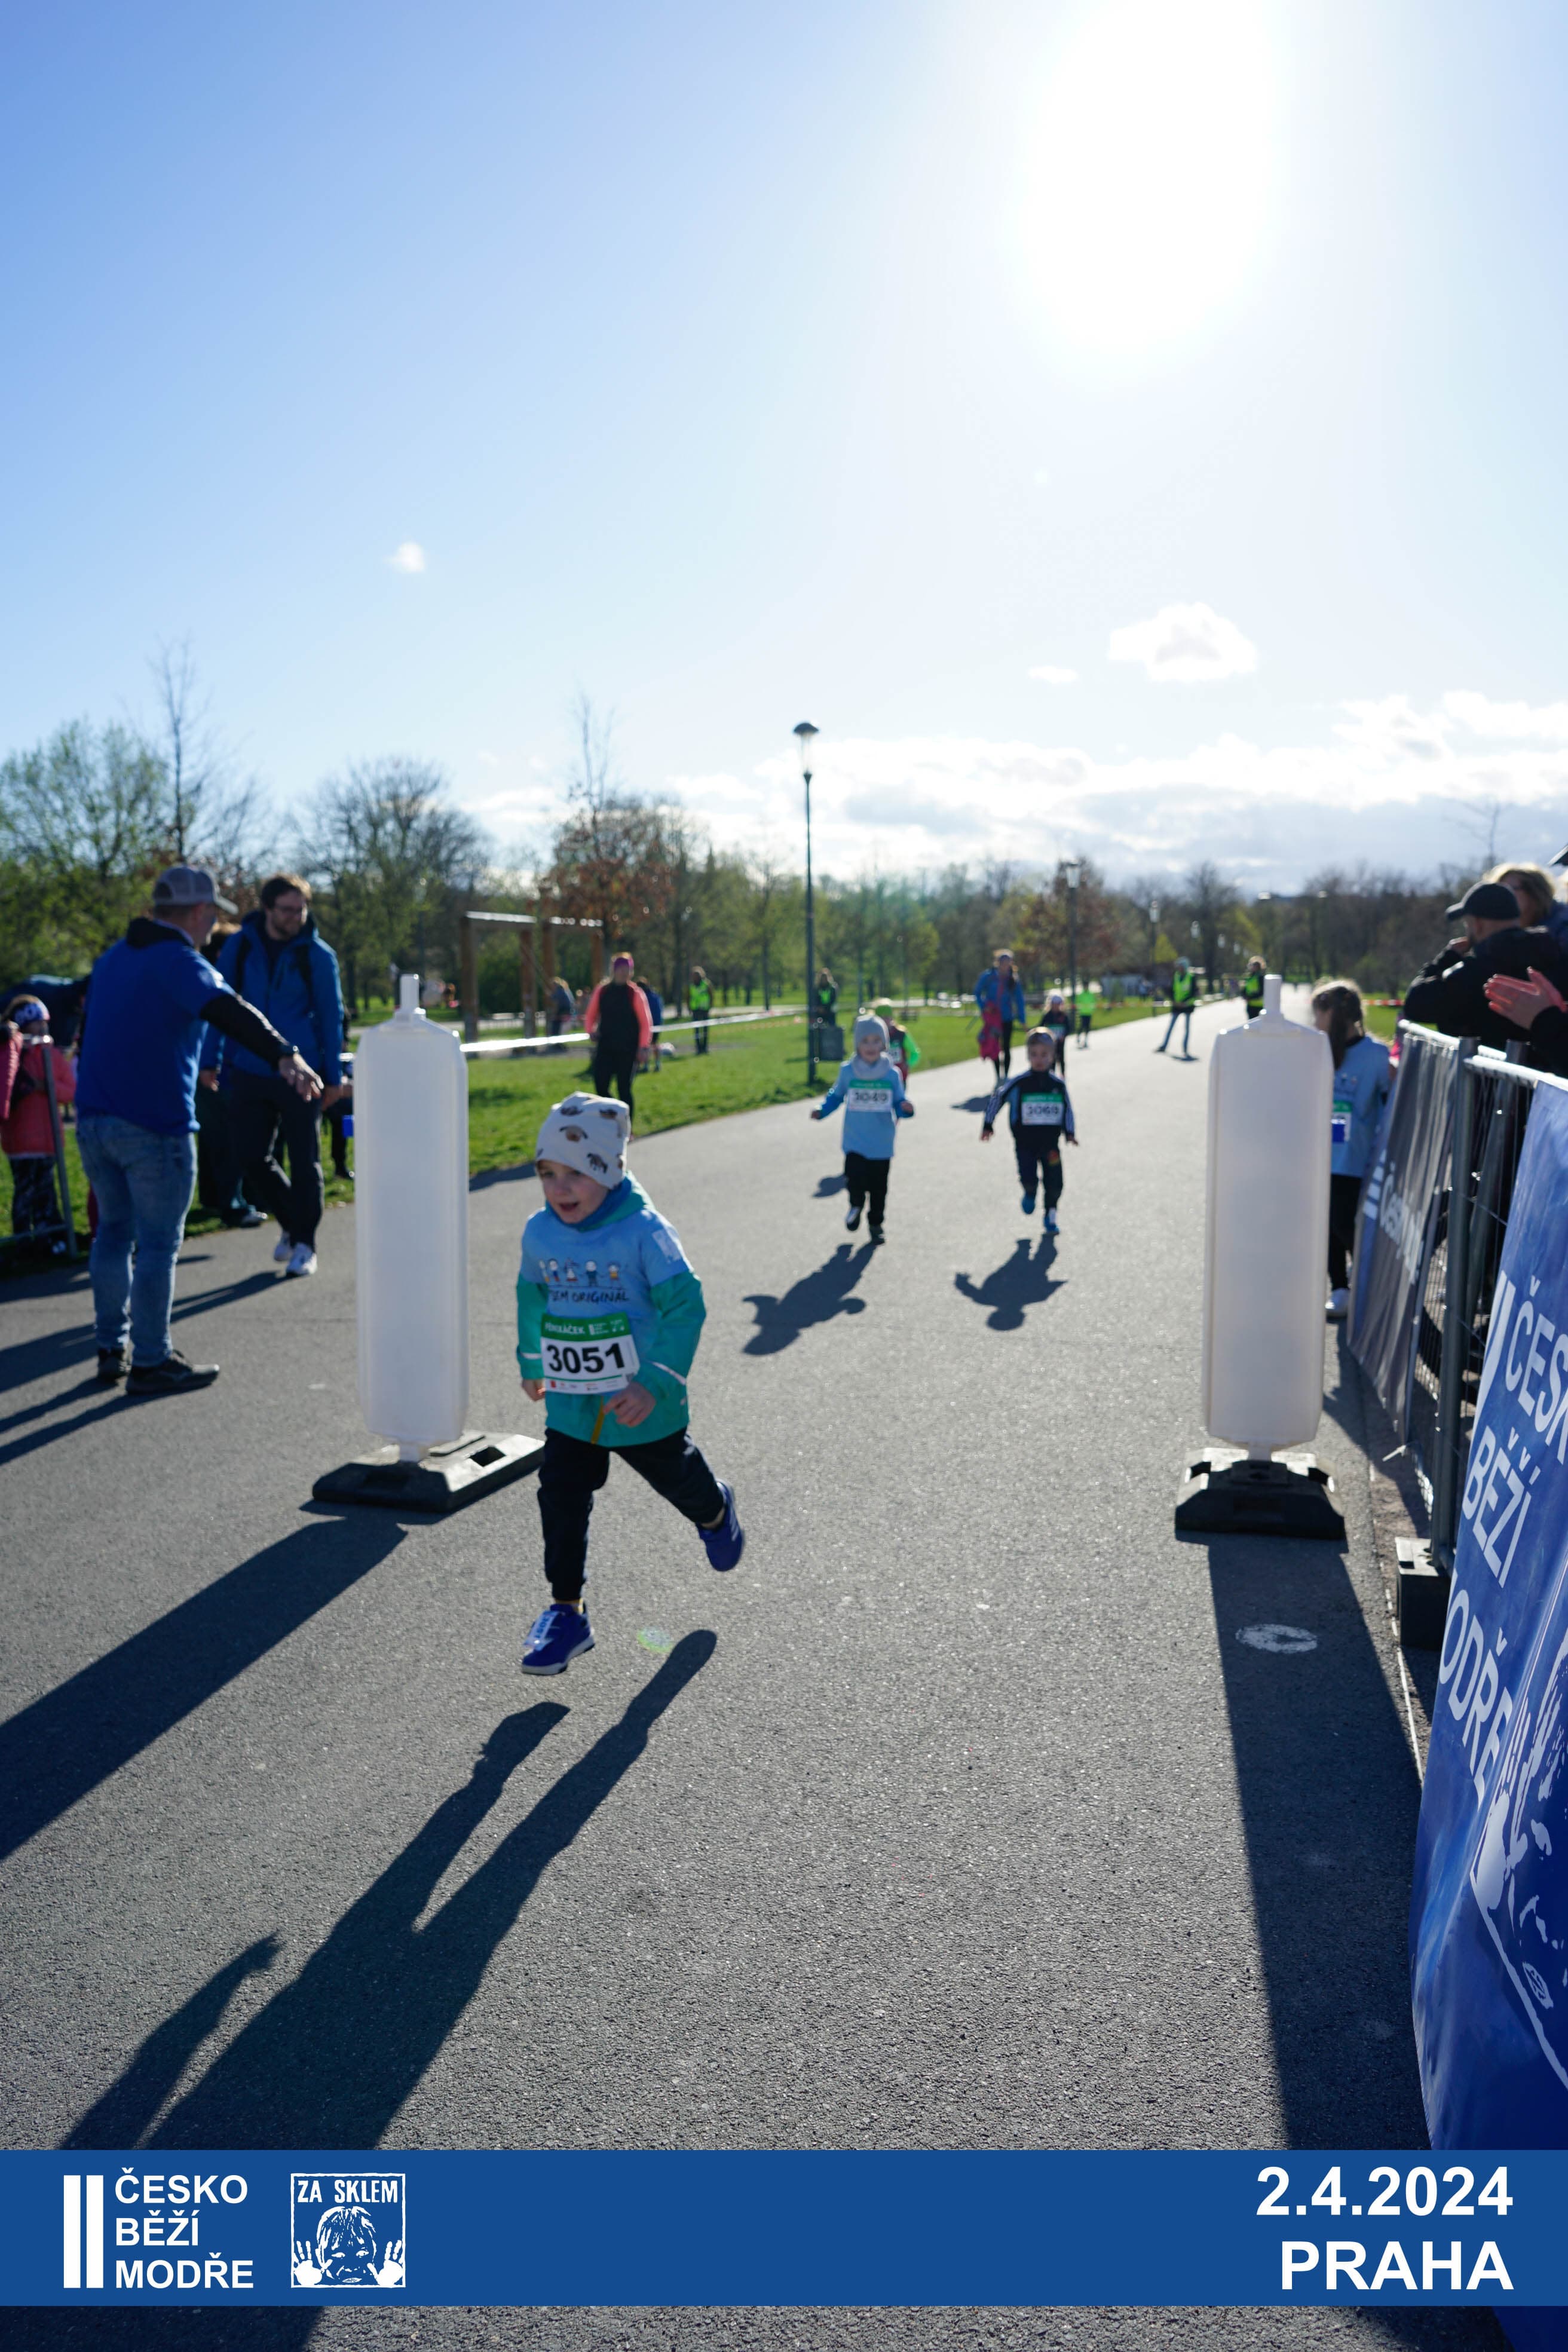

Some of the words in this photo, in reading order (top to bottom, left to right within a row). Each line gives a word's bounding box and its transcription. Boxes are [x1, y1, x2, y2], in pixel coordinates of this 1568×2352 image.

[547, 1343, 624, 1373] 3051
[1462, 1425, 1541, 1589] BĚŽÍ
[1439, 1567, 1512, 1810] ODŘE
